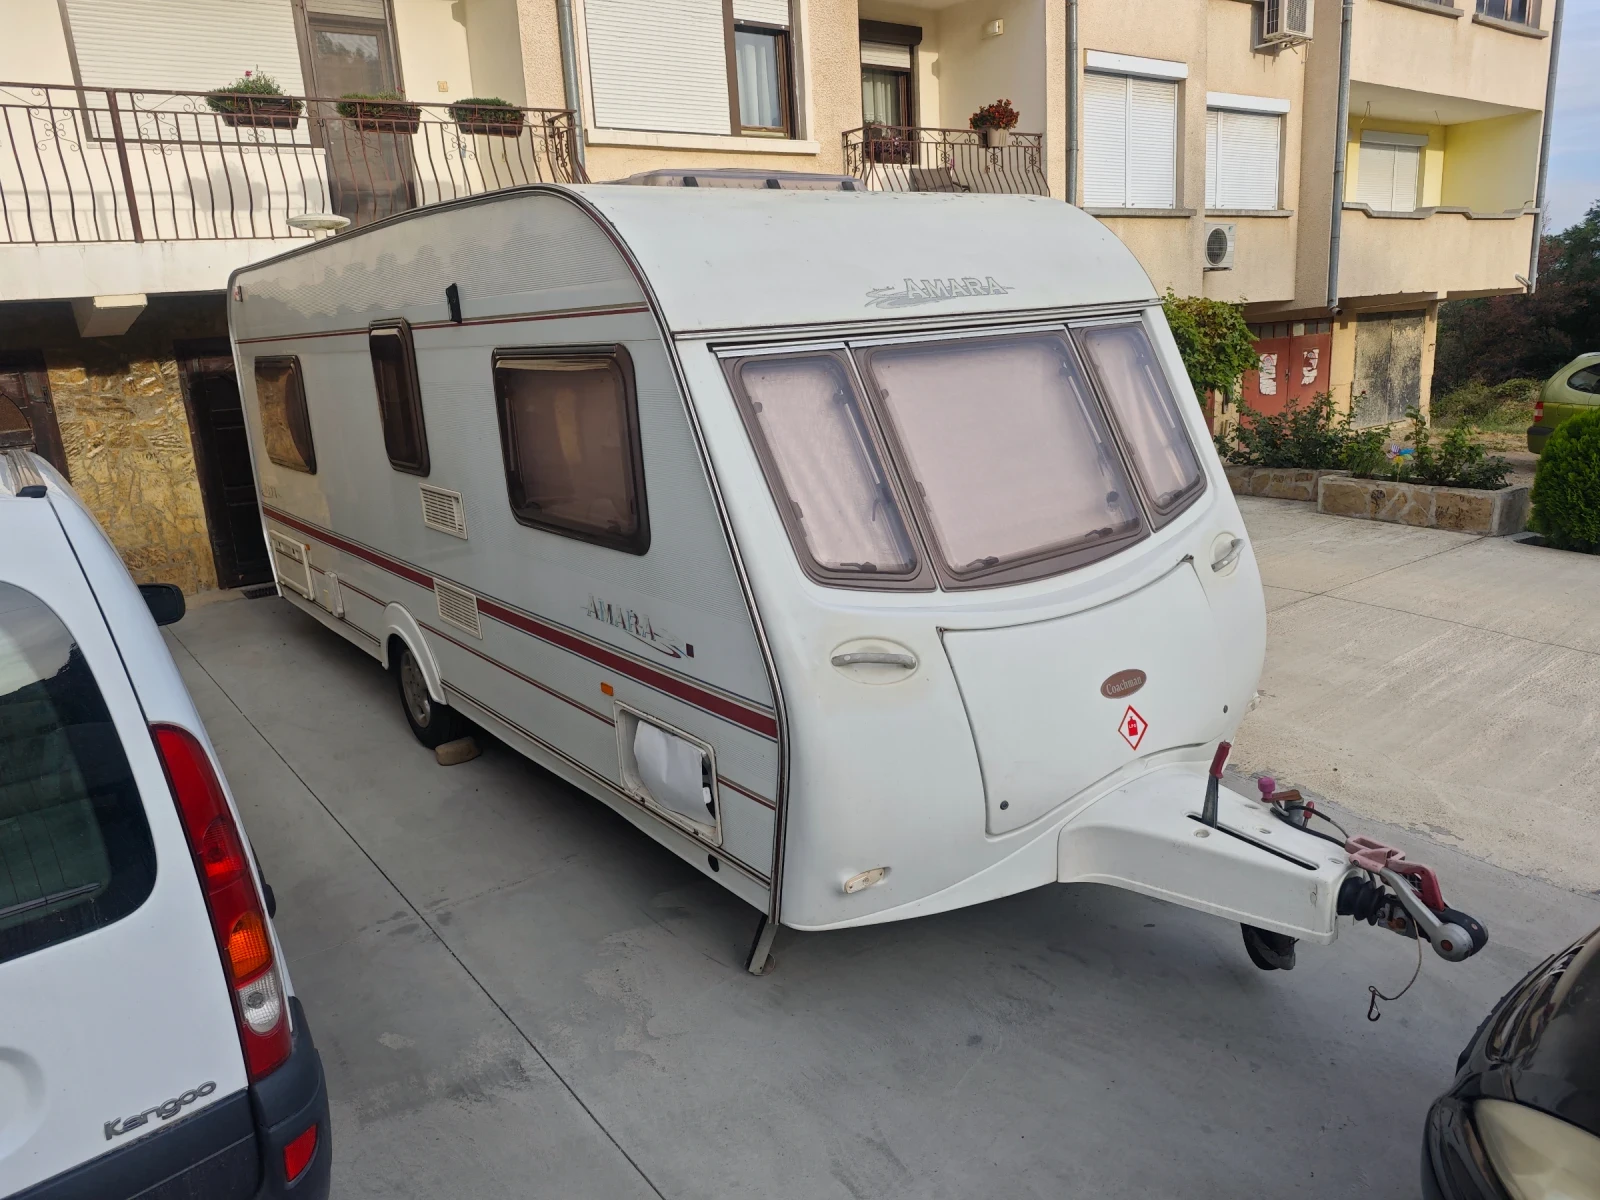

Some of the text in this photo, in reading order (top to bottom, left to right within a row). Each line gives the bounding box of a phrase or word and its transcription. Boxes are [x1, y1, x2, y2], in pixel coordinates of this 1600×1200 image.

[903, 276, 1009, 299] AMARA
[587, 593, 657, 641] AMARA
[1106, 676, 1143, 695] Coachman
[104, 1080, 217, 1141] Kangoo
